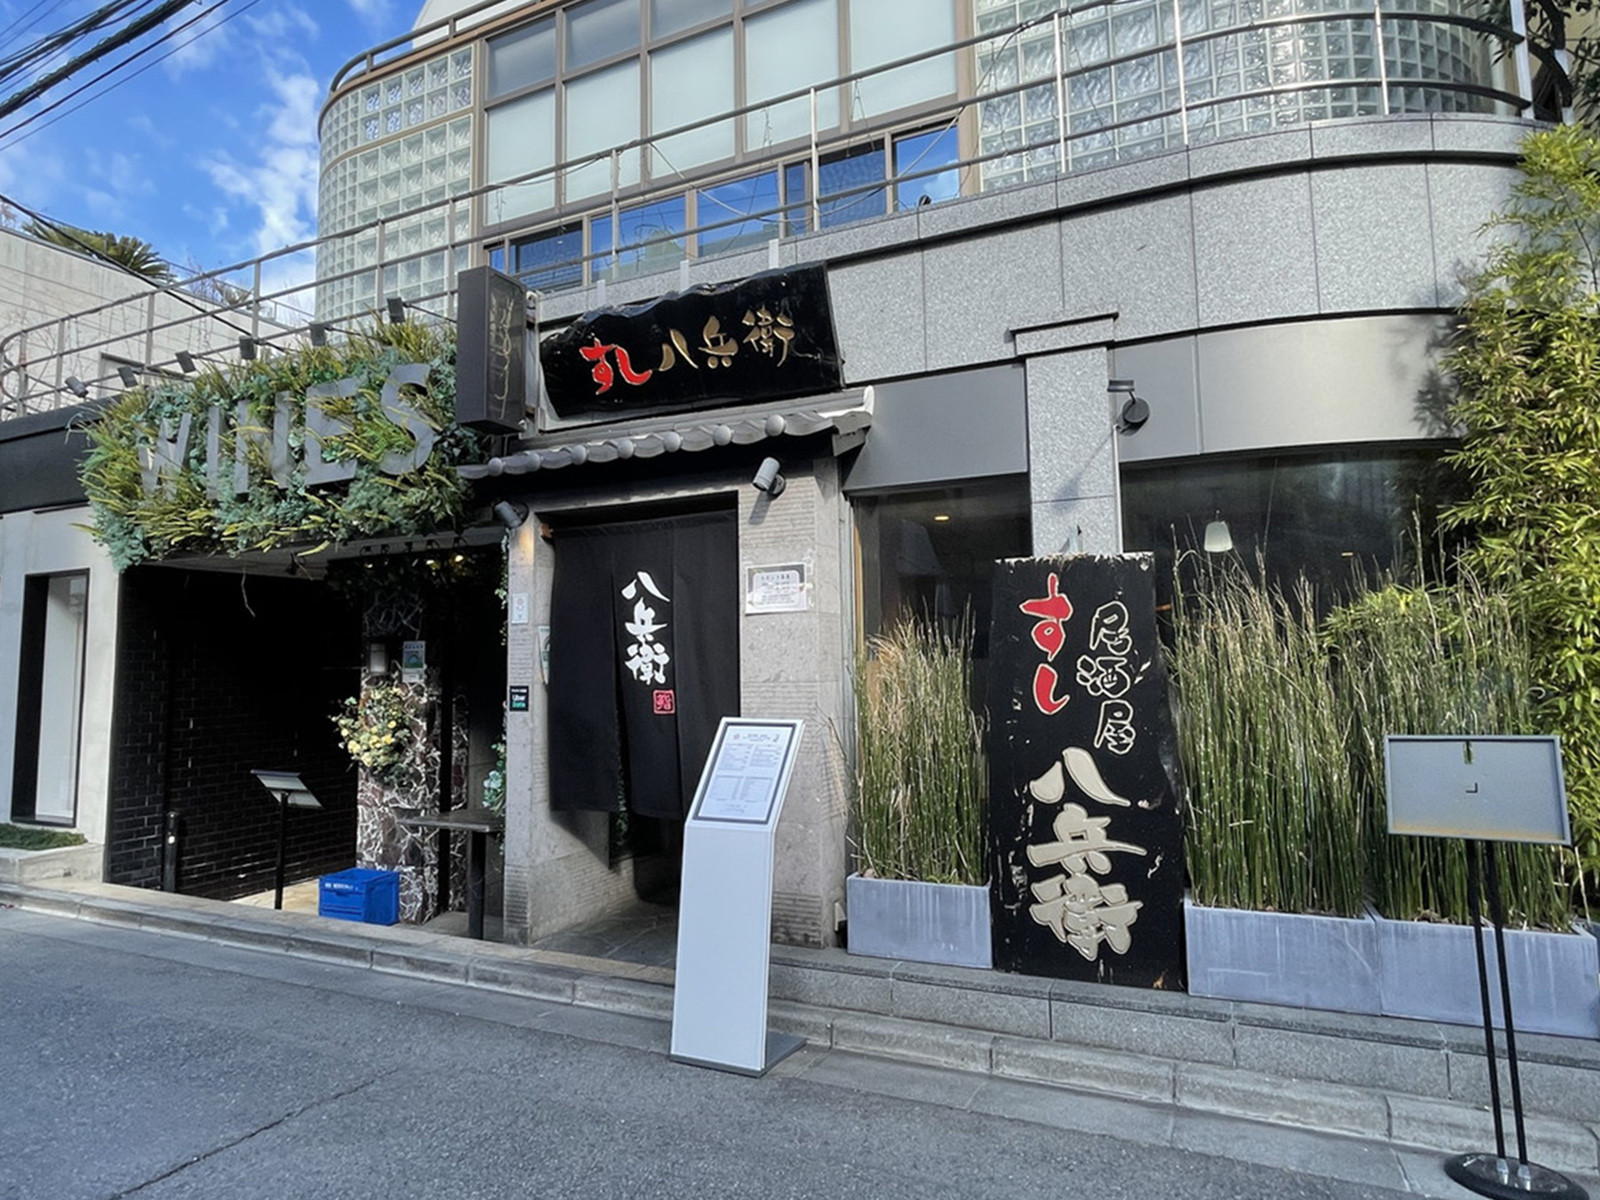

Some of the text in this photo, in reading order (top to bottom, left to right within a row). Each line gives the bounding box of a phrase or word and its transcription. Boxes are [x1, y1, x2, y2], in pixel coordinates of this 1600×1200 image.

[621, 571, 671, 685] 八兵衛
[1019, 572, 1074, 716] すし
[1026, 746, 1148, 962] 八兵衛
